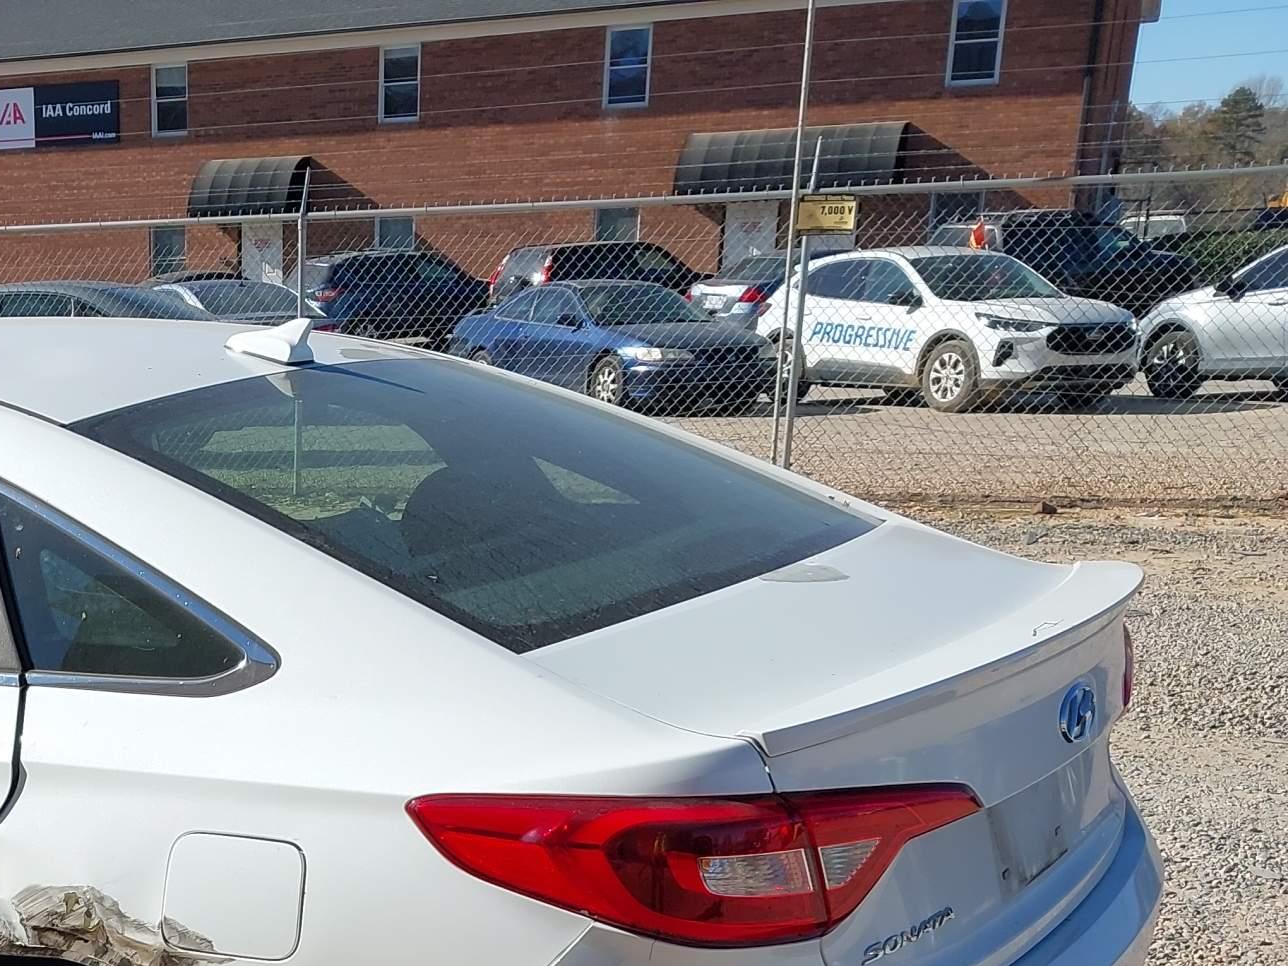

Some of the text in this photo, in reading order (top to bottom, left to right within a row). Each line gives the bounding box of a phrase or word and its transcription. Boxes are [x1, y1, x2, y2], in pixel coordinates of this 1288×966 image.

[42, 101, 111, 118] IAA Concord
[819, 205, 854, 216] 7,000 V
[809, 321, 917, 351] PROGRESSIVE
[860, 906, 956, 966] SONATA
